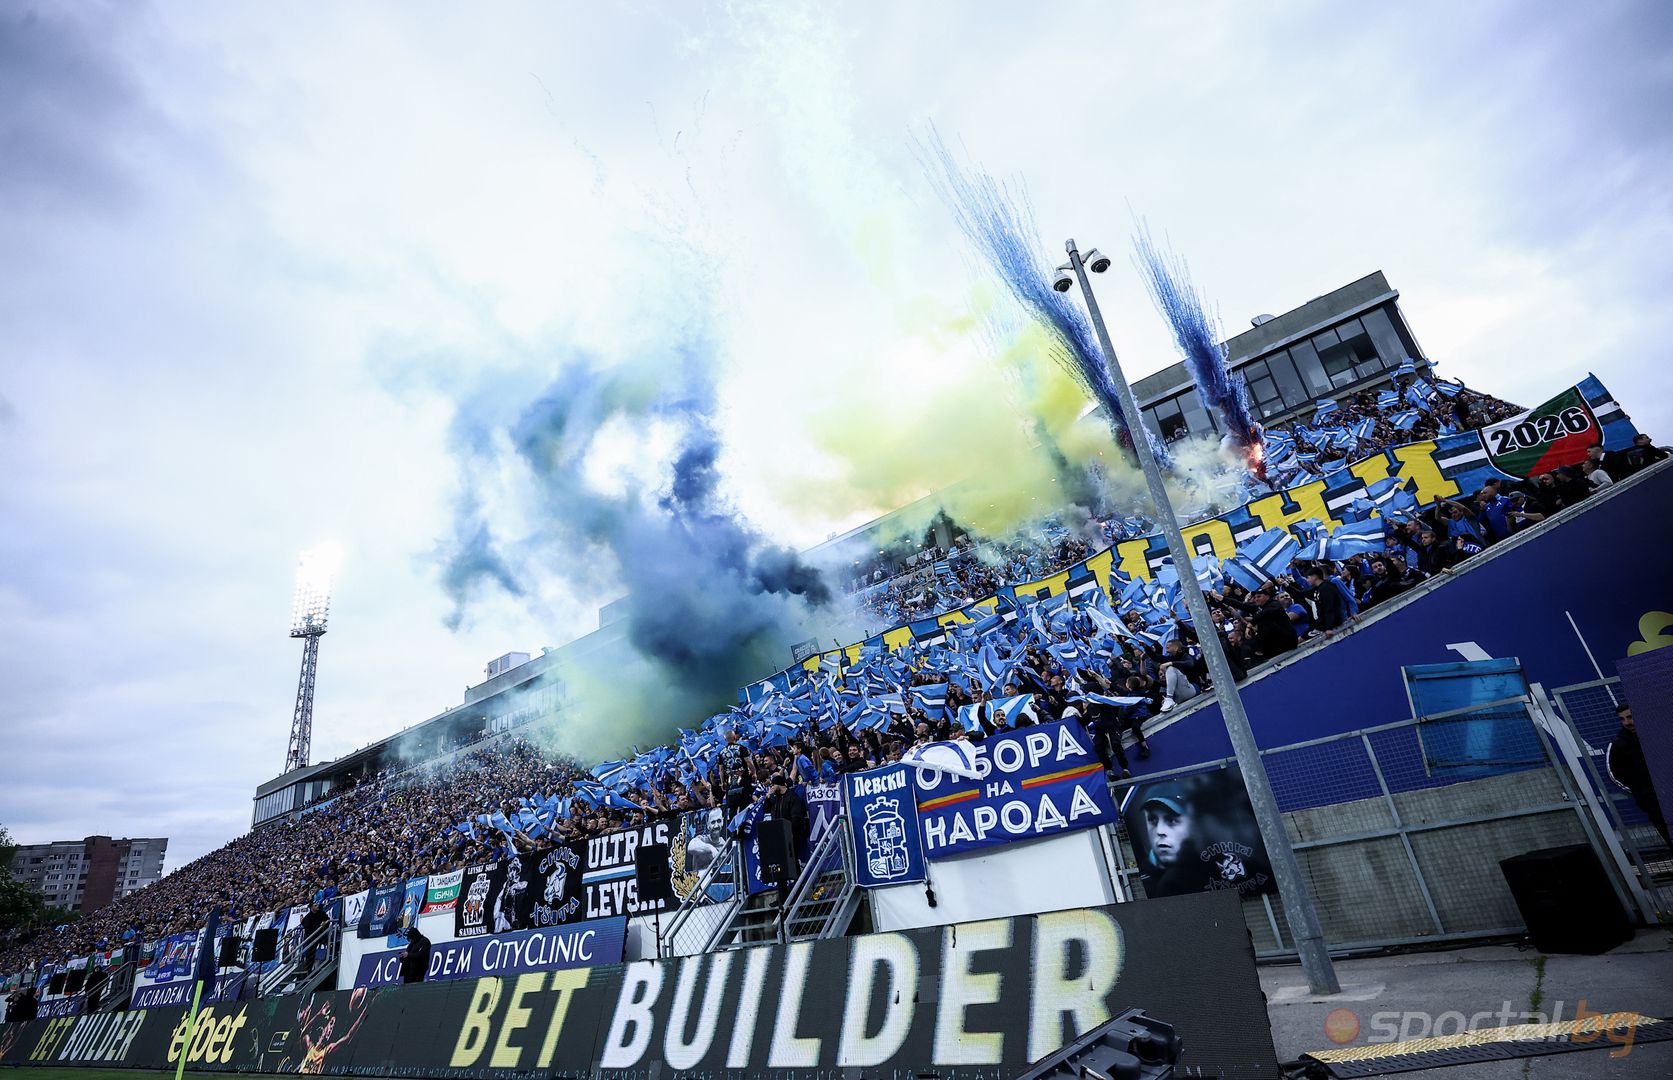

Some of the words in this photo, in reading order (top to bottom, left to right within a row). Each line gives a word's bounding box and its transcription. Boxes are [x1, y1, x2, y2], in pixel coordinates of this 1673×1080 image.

[1490, 406, 1591, 457] 2026
[915, 725, 1088, 791] ОБОРА
[854, 770, 907, 798] Левски
[986, 780, 1014, 798] НА
[925, 784, 1102, 850] НАРОДА
[588, 823, 669, 868] ULTRAS
[464, 909, 483, 925] TEAM
[586, 878, 665, 918] LEVS
[370, 945, 473, 983] ACIDEM
[137, 984, 186, 1007] ACIBADEM
[449, 968, 592, 1068] BET
[601, 910, 1126, 1070] BUILDER
[29, 1016, 76, 1061] BET
[58, 1009, 147, 1061] BUILDER
[167, 1003, 249, 1064] efbet
